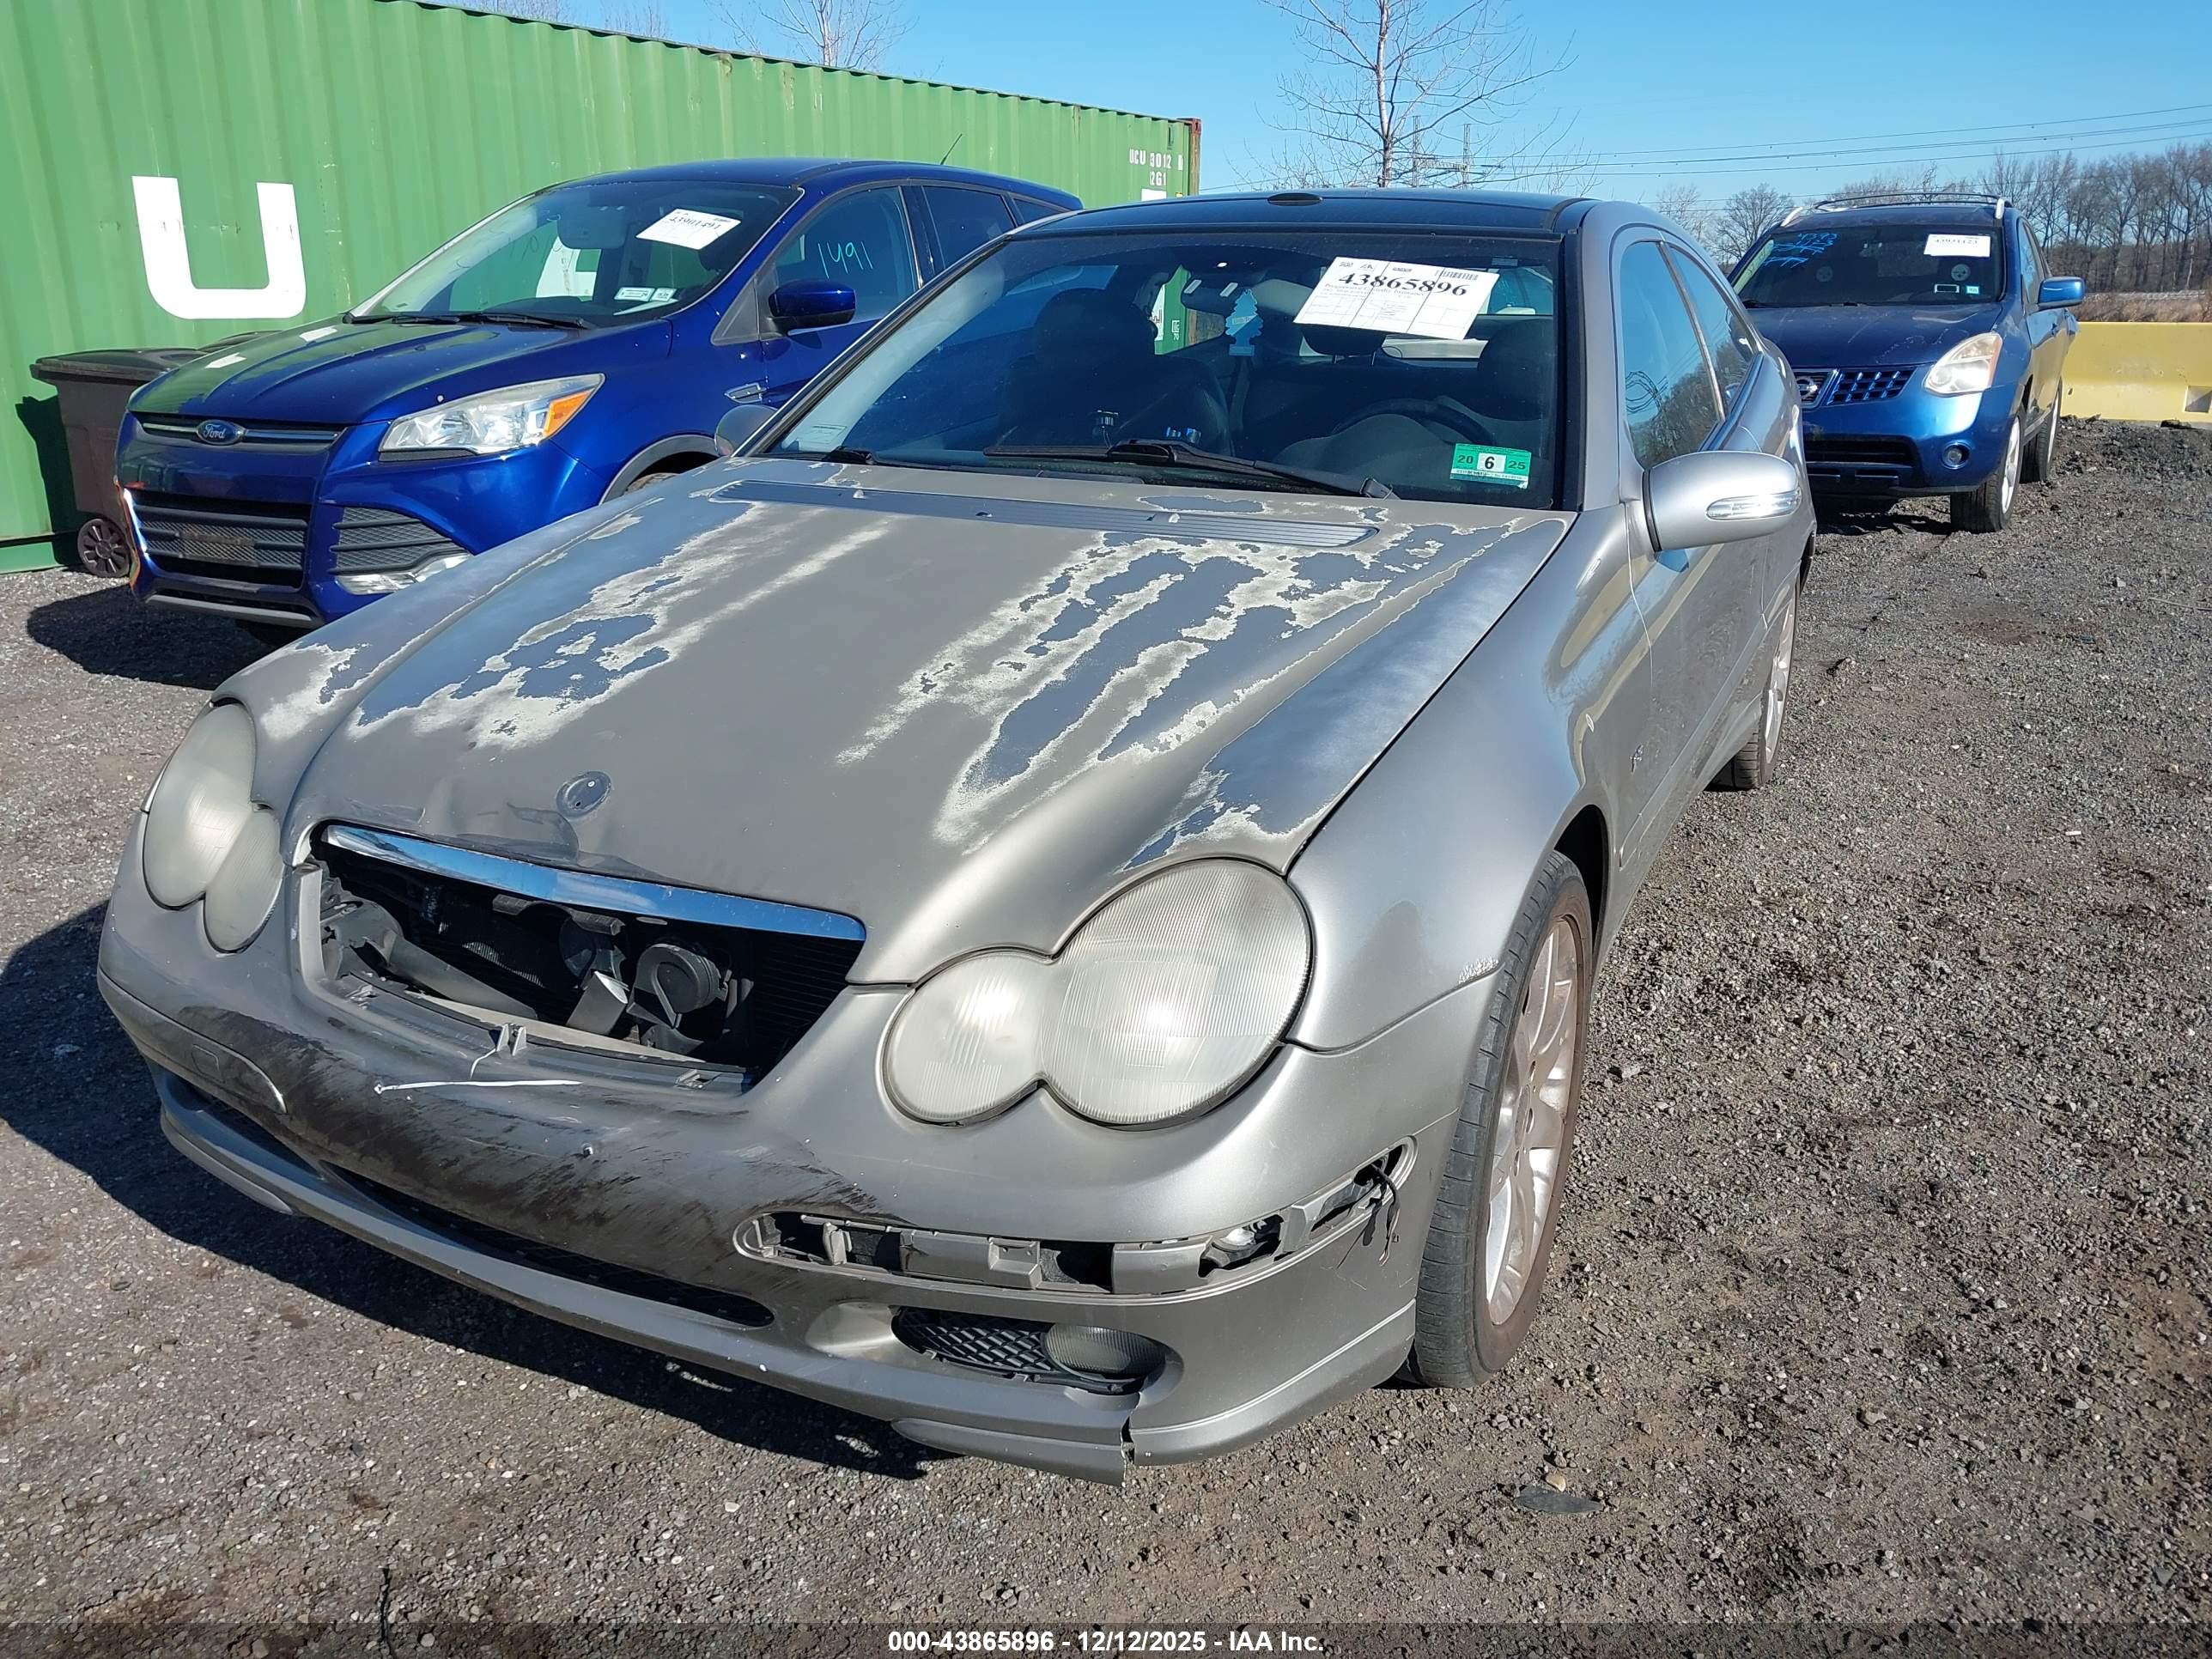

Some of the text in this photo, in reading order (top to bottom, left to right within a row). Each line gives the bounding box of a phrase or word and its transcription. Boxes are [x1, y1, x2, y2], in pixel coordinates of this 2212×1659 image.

[131, 175, 307, 319] U
[817, 240, 873, 279] 1491
[1338, 272, 1471, 296] 43865896
[202, 423, 227, 439] Ford
[1457, 455, 1526, 470] 20 6 25
